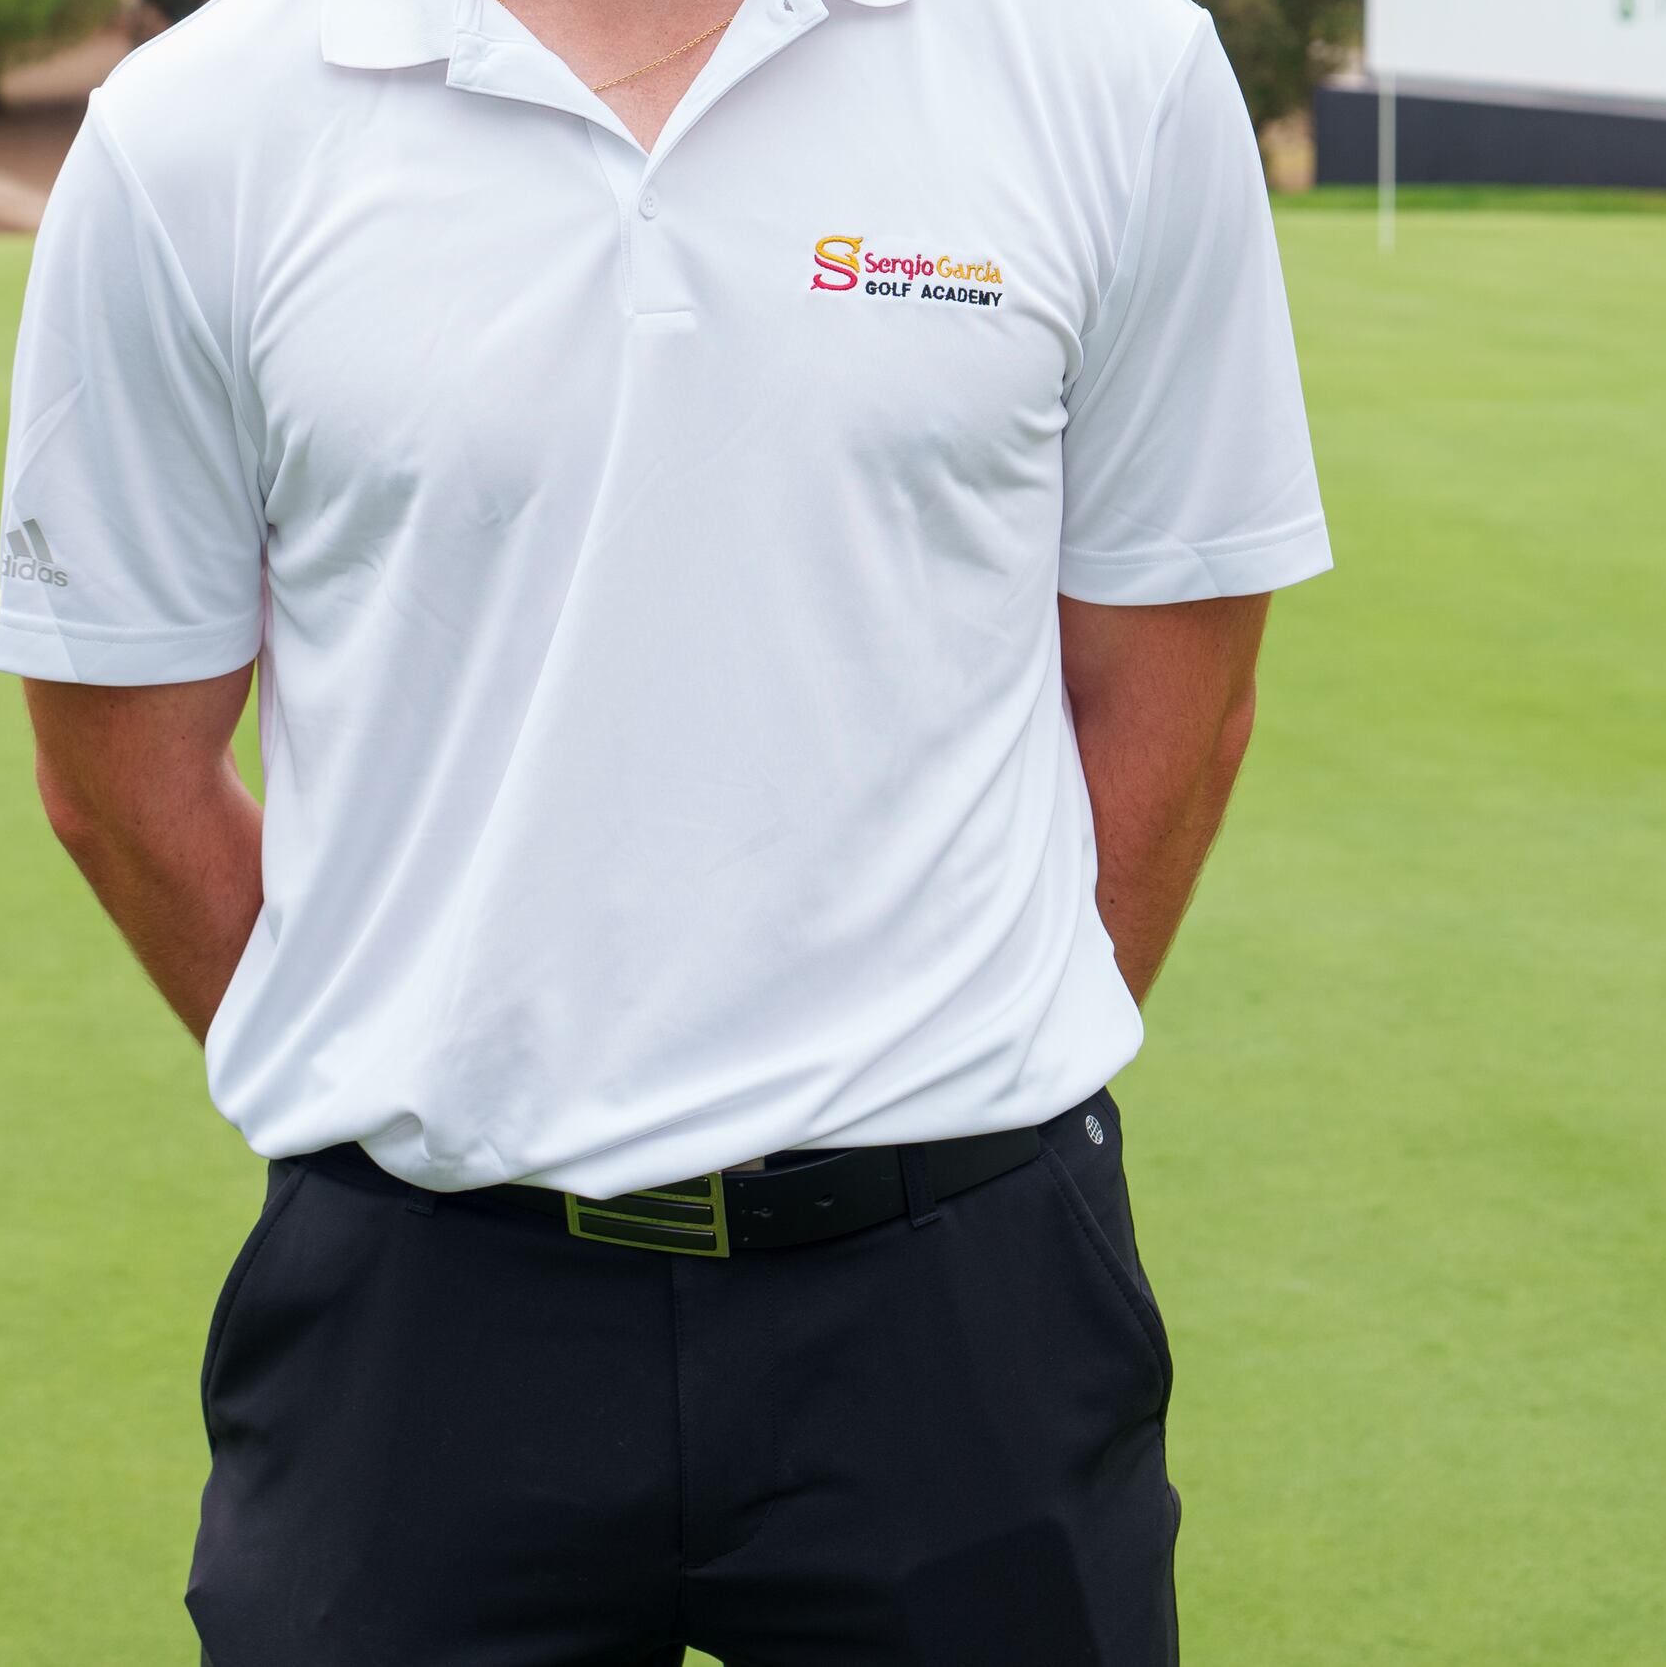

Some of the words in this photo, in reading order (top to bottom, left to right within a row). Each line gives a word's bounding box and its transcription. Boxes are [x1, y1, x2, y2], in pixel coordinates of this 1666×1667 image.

[864, 251, 934, 281] Sergio
[865, 280, 912, 298] GOLF
[921, 283, 1003, 307] ACADEMY
